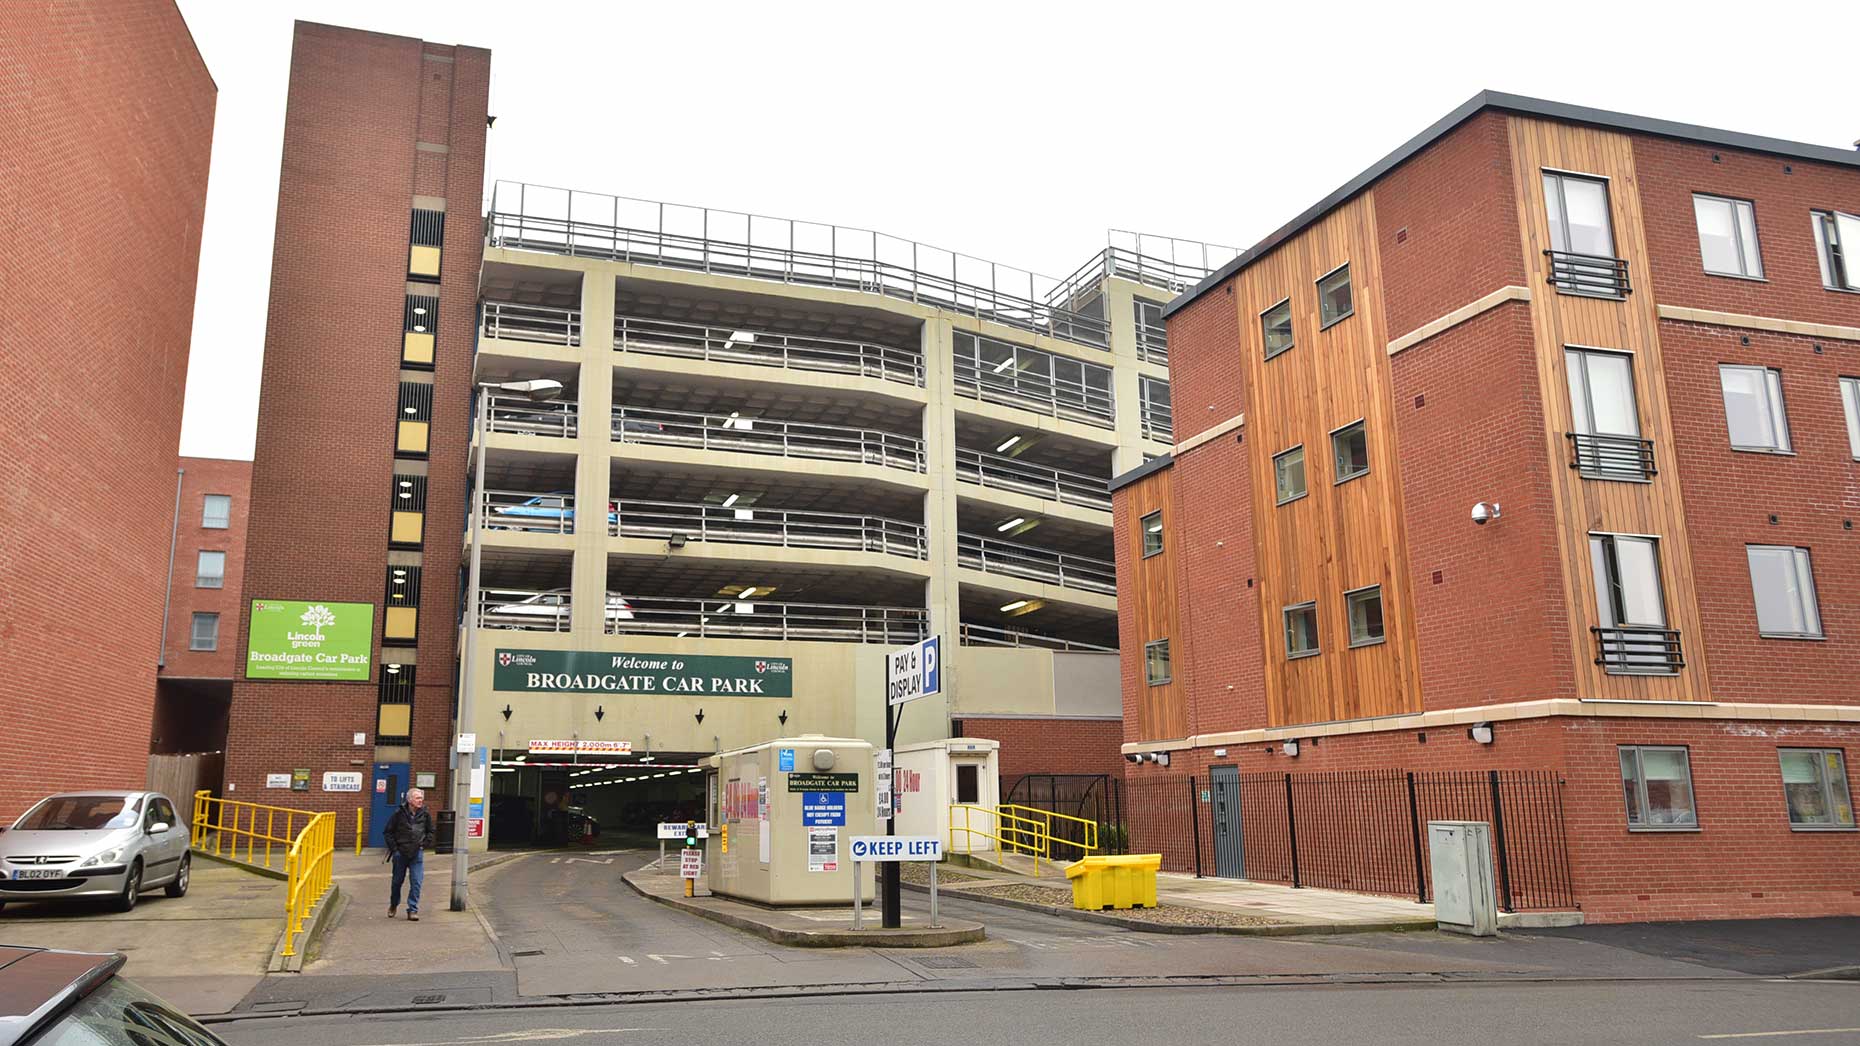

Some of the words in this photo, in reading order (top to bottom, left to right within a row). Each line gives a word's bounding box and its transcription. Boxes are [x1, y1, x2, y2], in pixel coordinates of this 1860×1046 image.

[287, 631, 325, 641] Lincoln
[291, 640, 320, 649] green
[251, 650, 312, 664] Broadgate
[315, 652, 337, 663] Car
[340, 653, 368, 664] Park
[512, 655, 537, 663] Lincoln
[611, 656, 668, 670] Welcome
[672, 660, 684, 670] to
[895, 652, 909, 675] PAY
[911, 650, 916, 669] &
[767, 663, 789, 671] Lincoln
[925, 645, 936, 688] P
[527, 672, 656, 691] BROADGATE
[663, 676, 704, 692] CAR
[711, 678, 764, 693] PARK
[891, 673, 921, 700] DISPLAY
[330, 783, 361, 791] STAIRCASE
[869, 841, 902, 855] KEEP
[909, 841, 939, 855] LEFT
[19, 869, 41, 879] BL02
[43, 869, 61, 878] OYF
